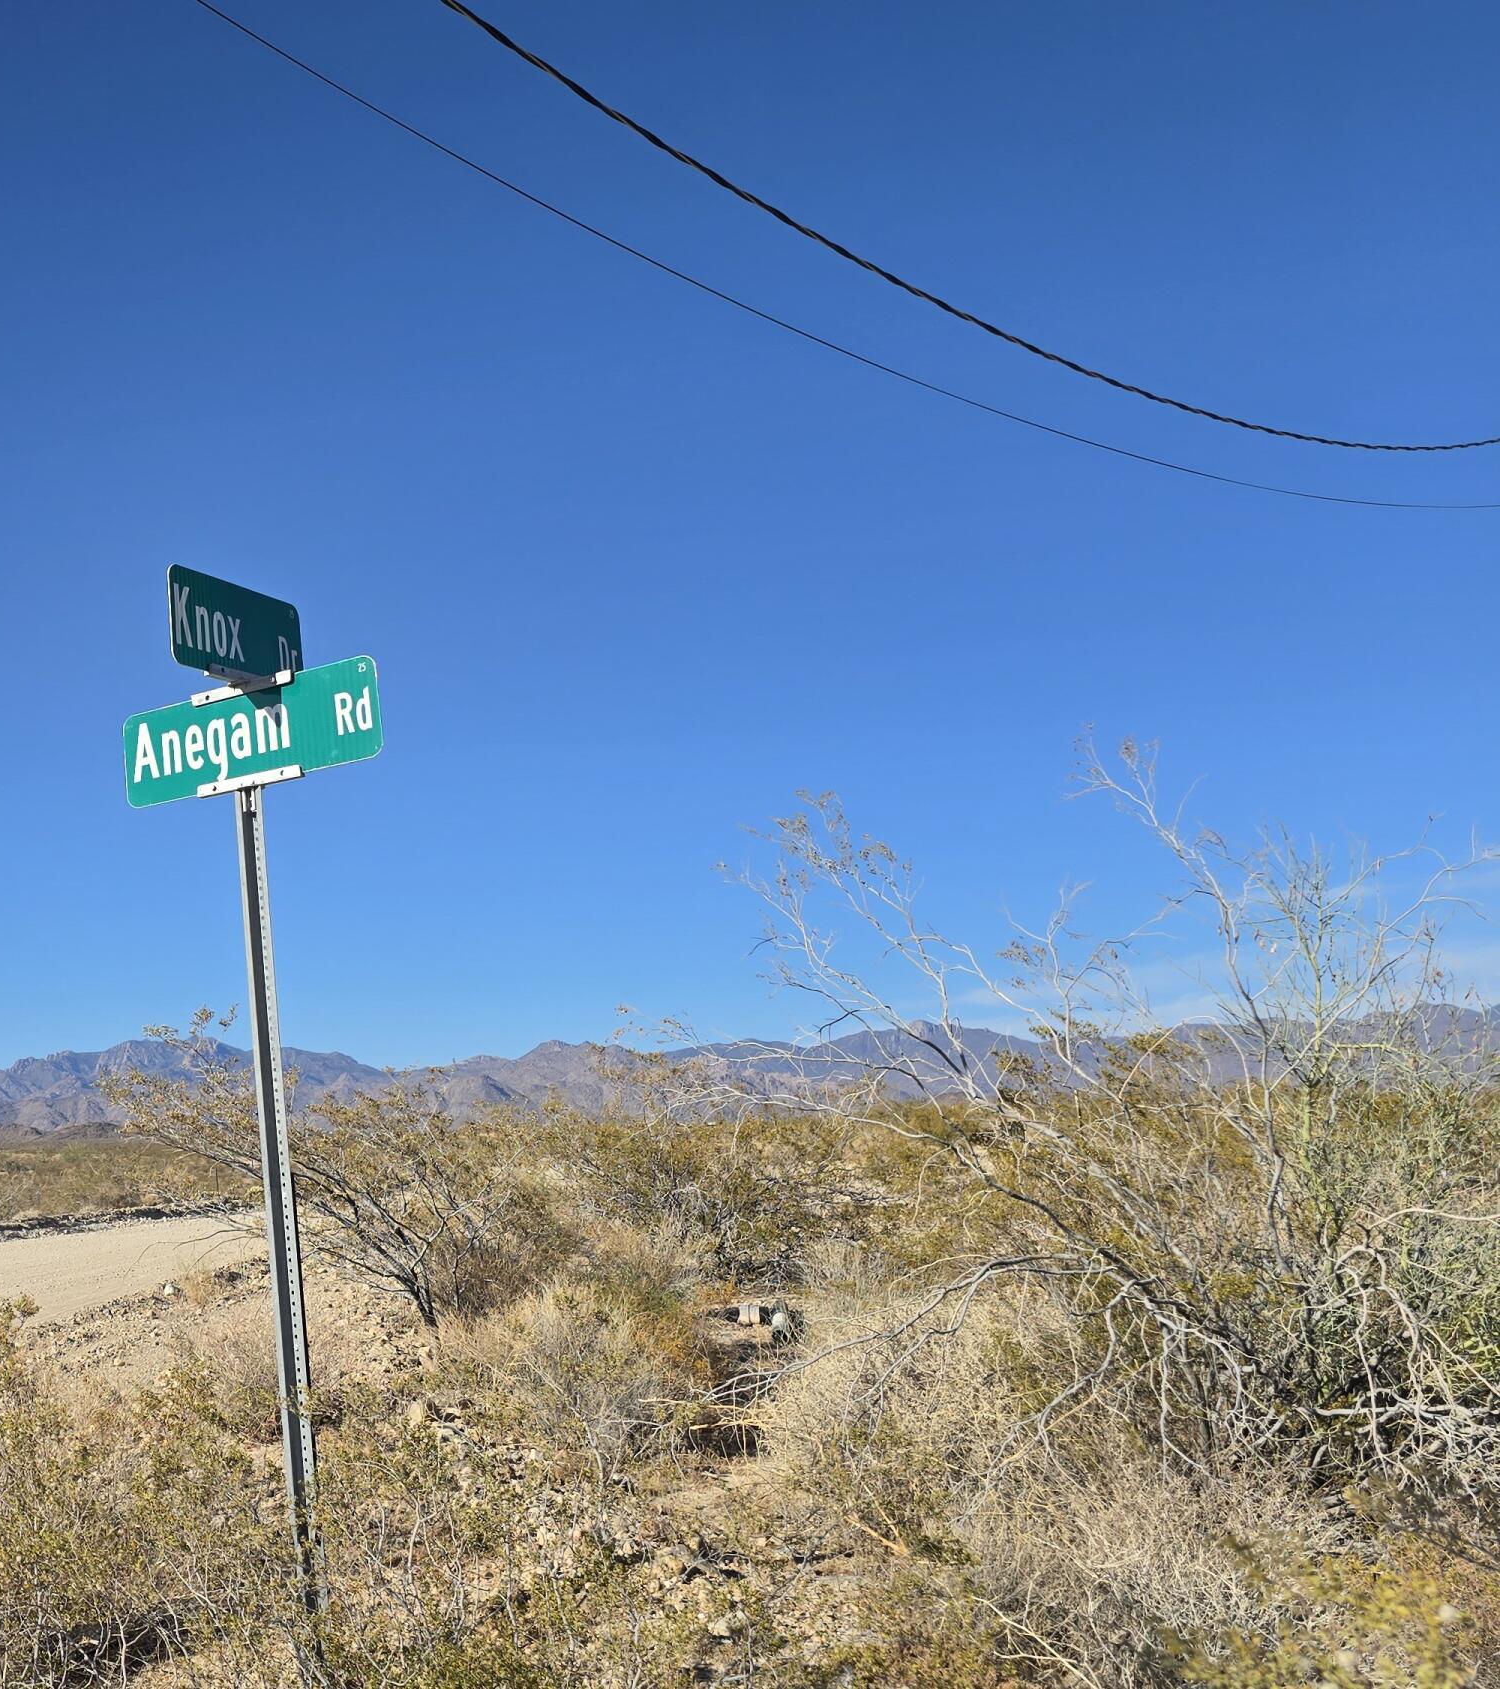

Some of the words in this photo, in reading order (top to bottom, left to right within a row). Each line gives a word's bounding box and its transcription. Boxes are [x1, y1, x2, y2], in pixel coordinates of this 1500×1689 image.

[173, 583, 244, 662] Knox
[278, 636, 298, 672] Dr
[357, 662, 367, 673] 25
[134, 703, 290, 783] Anegam
[334, 686, 373, 735] Rd
